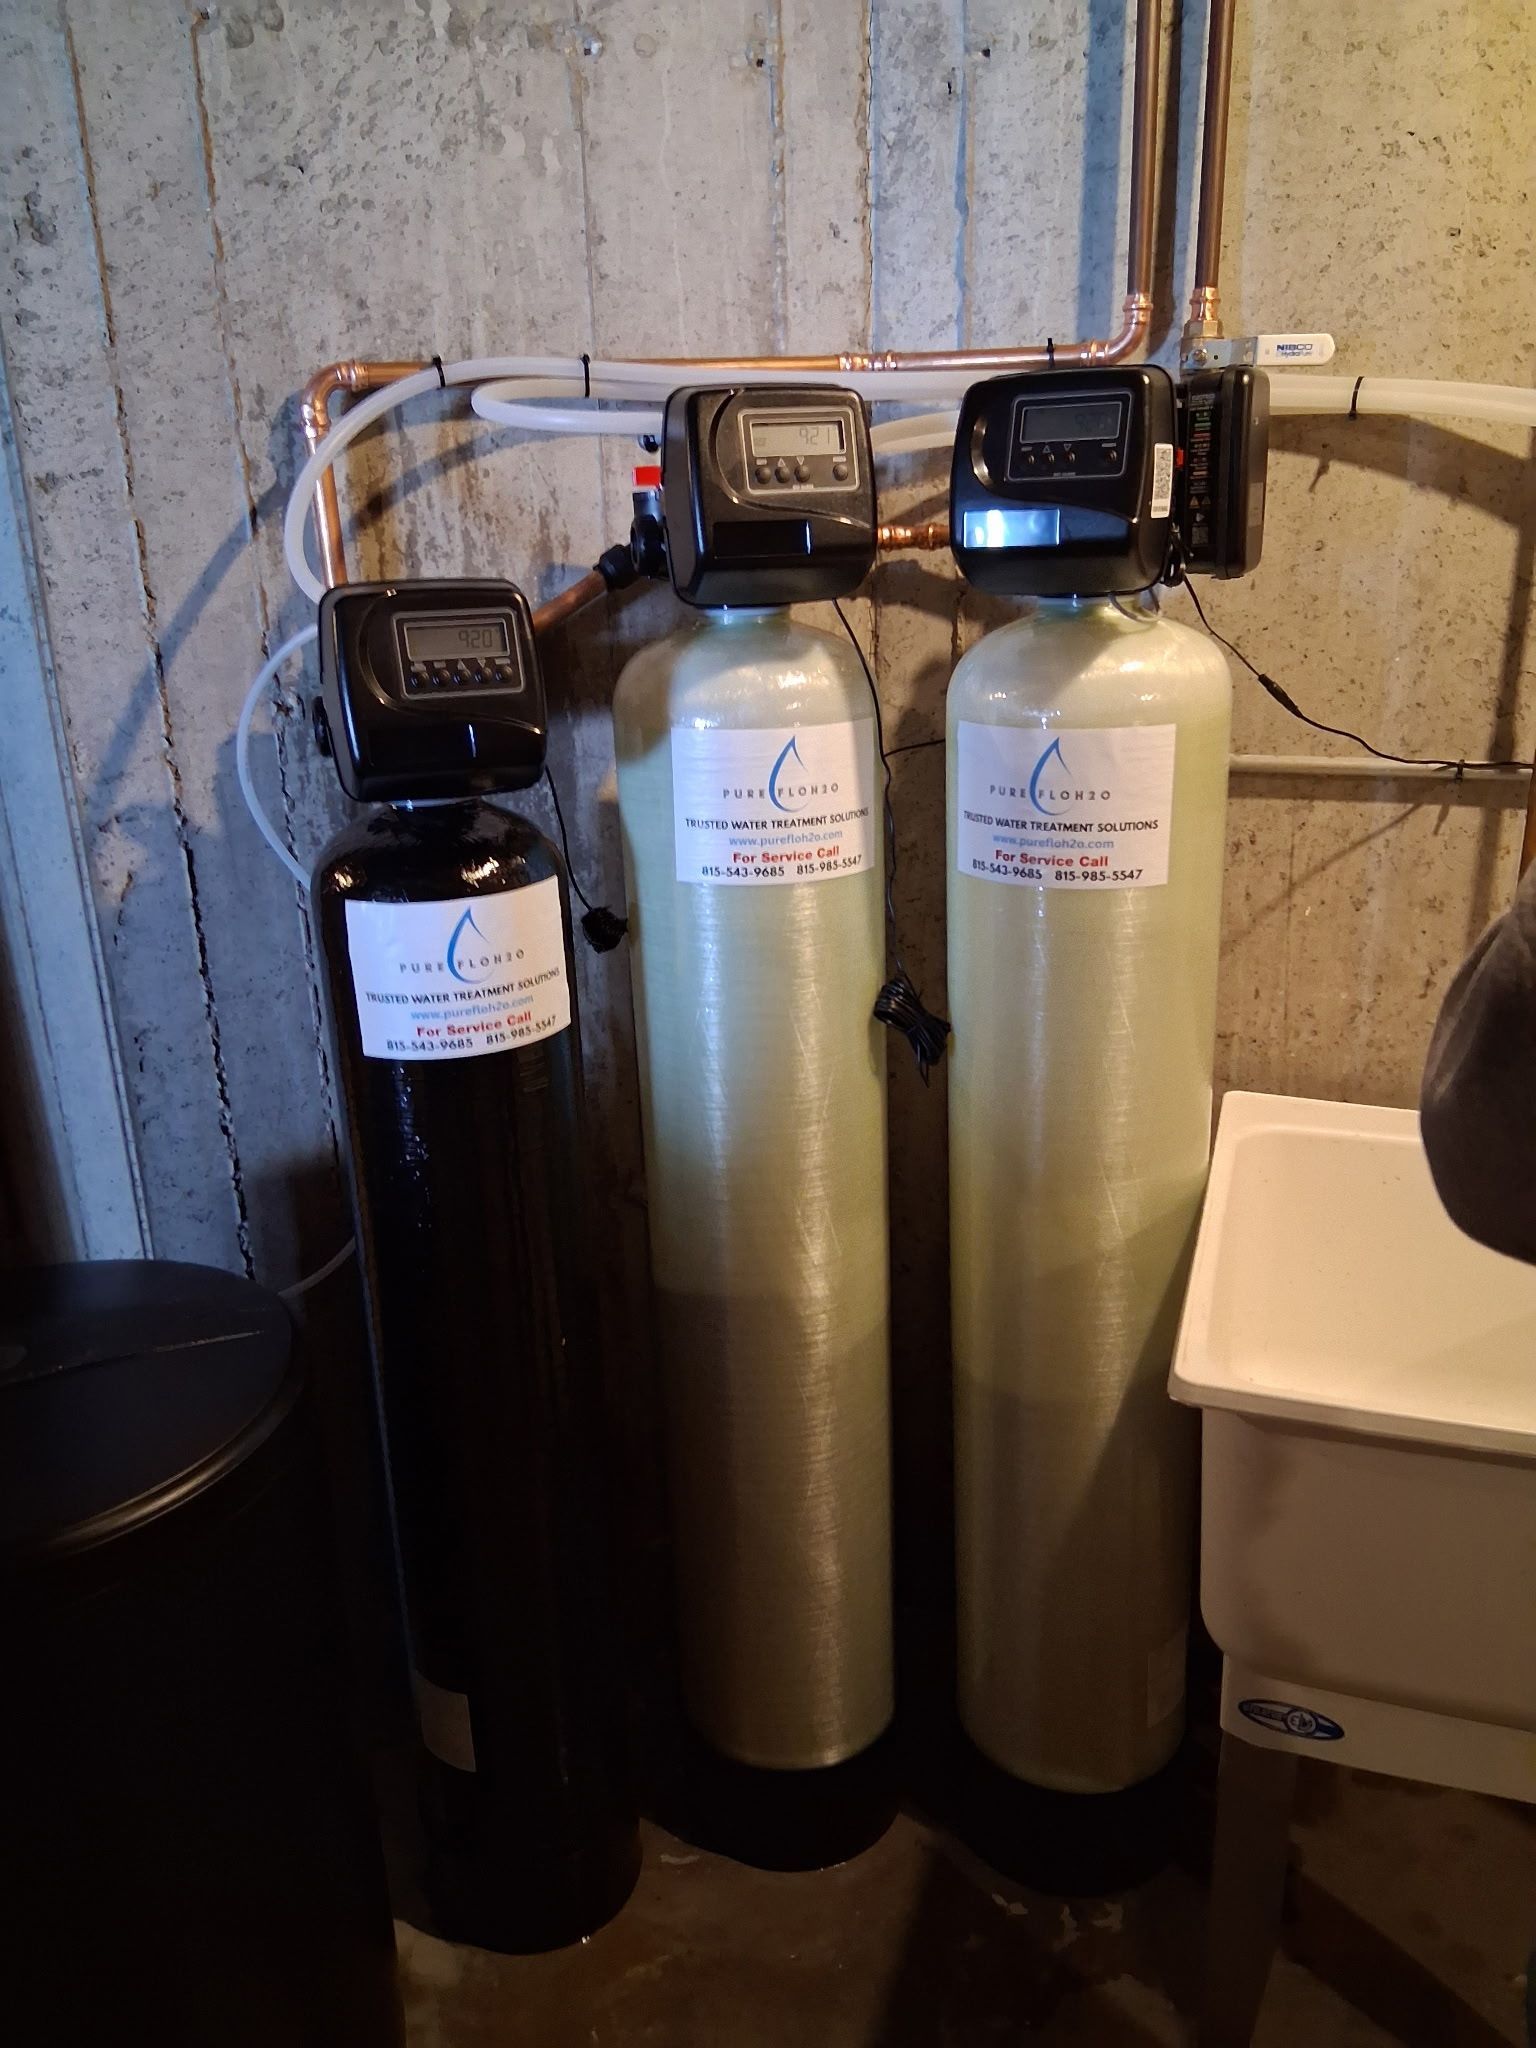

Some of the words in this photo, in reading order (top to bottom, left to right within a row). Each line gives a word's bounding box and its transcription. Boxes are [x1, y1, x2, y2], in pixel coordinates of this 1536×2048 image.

[458, 628, 493, 648] 920
[686, 818, 728, 829] TRUSTED
[732, 820, 767, 830] WATER
[772, 817, 827, 829] TREATMENT
[830, 808, 869, 824] SOLUTIONS
[964, 810, 993, 825] TRUSTED
[996, 817, 1027, 830] WATER
[1031, 820, 1094, 833] TREATMENT
[1098, 820, 1158, 832] SOLUTIONS
[729, 831, 842, 847] www.purefloh2o.com
[993, 835, 1114, 849] www.purefloh2o.com
[733, 853, 755, 863] For
[762, 849, 812, 863] Service
[817, 846, 839, 858] Call
[995, 850, 1016, 862] For
[1020, 853, 1073, 867] Service
[1080, 856, 1108, 867] Call
[702, 866, 784, 877] 815-543-9685
[796, 855, 861, 875] 815-985-5547
[973, 859, 1042, 879] 815-543-9685
[1055, 869, 1143, 881] 815-985-5547
[367, 992, 408, 1004] TRUSTED
[411, 992, 449, 1004] WATER
[454, 984, 514, 1001] TREATMENT
[518, 968, 560, 990] SOLUTIONS
[411, 995, 534, 1021] www.purefloh2o.com
[387, 1040, 473, 1050] 815-543-9685
[486, 1015, 556, 1044] 815-985-5547
[416, 1026, 440, 1037] For
[447, 1019, 501, 1035] Service
[507, 1012, 531, 1025] Call
